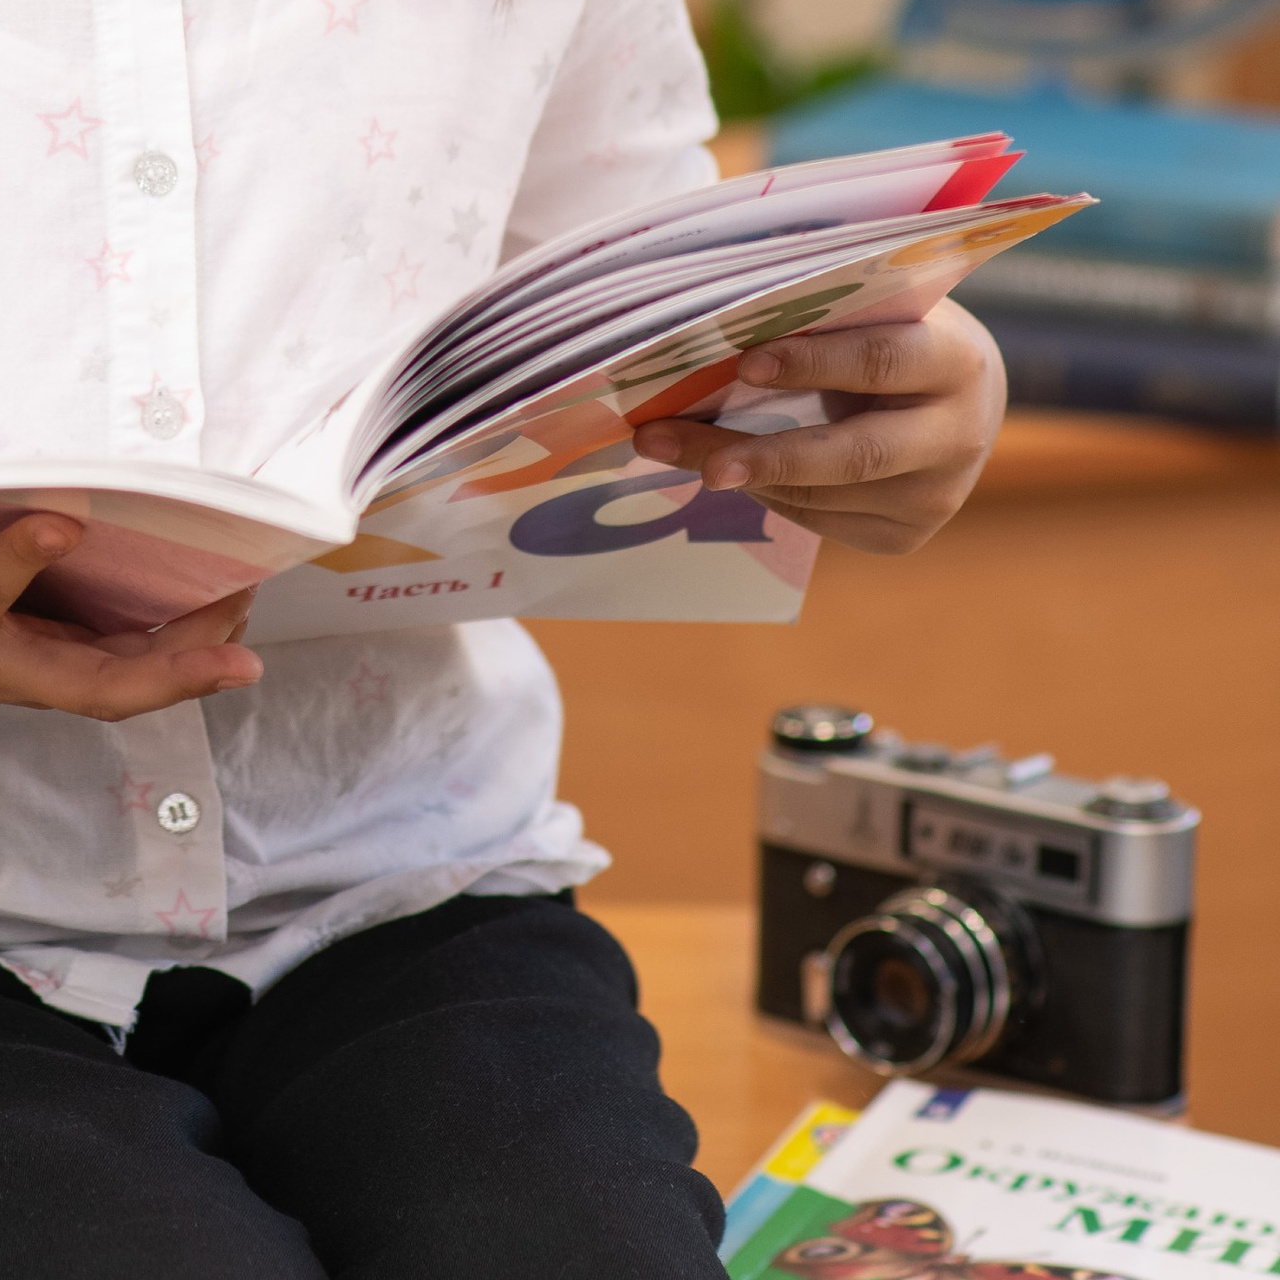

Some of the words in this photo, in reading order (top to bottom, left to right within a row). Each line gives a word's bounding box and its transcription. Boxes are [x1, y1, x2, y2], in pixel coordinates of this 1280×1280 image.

[345, 577, 471, 603] Часть
[484, 570, 507, 591] 1
[1051, 1204, 1280, 1275] МИ
